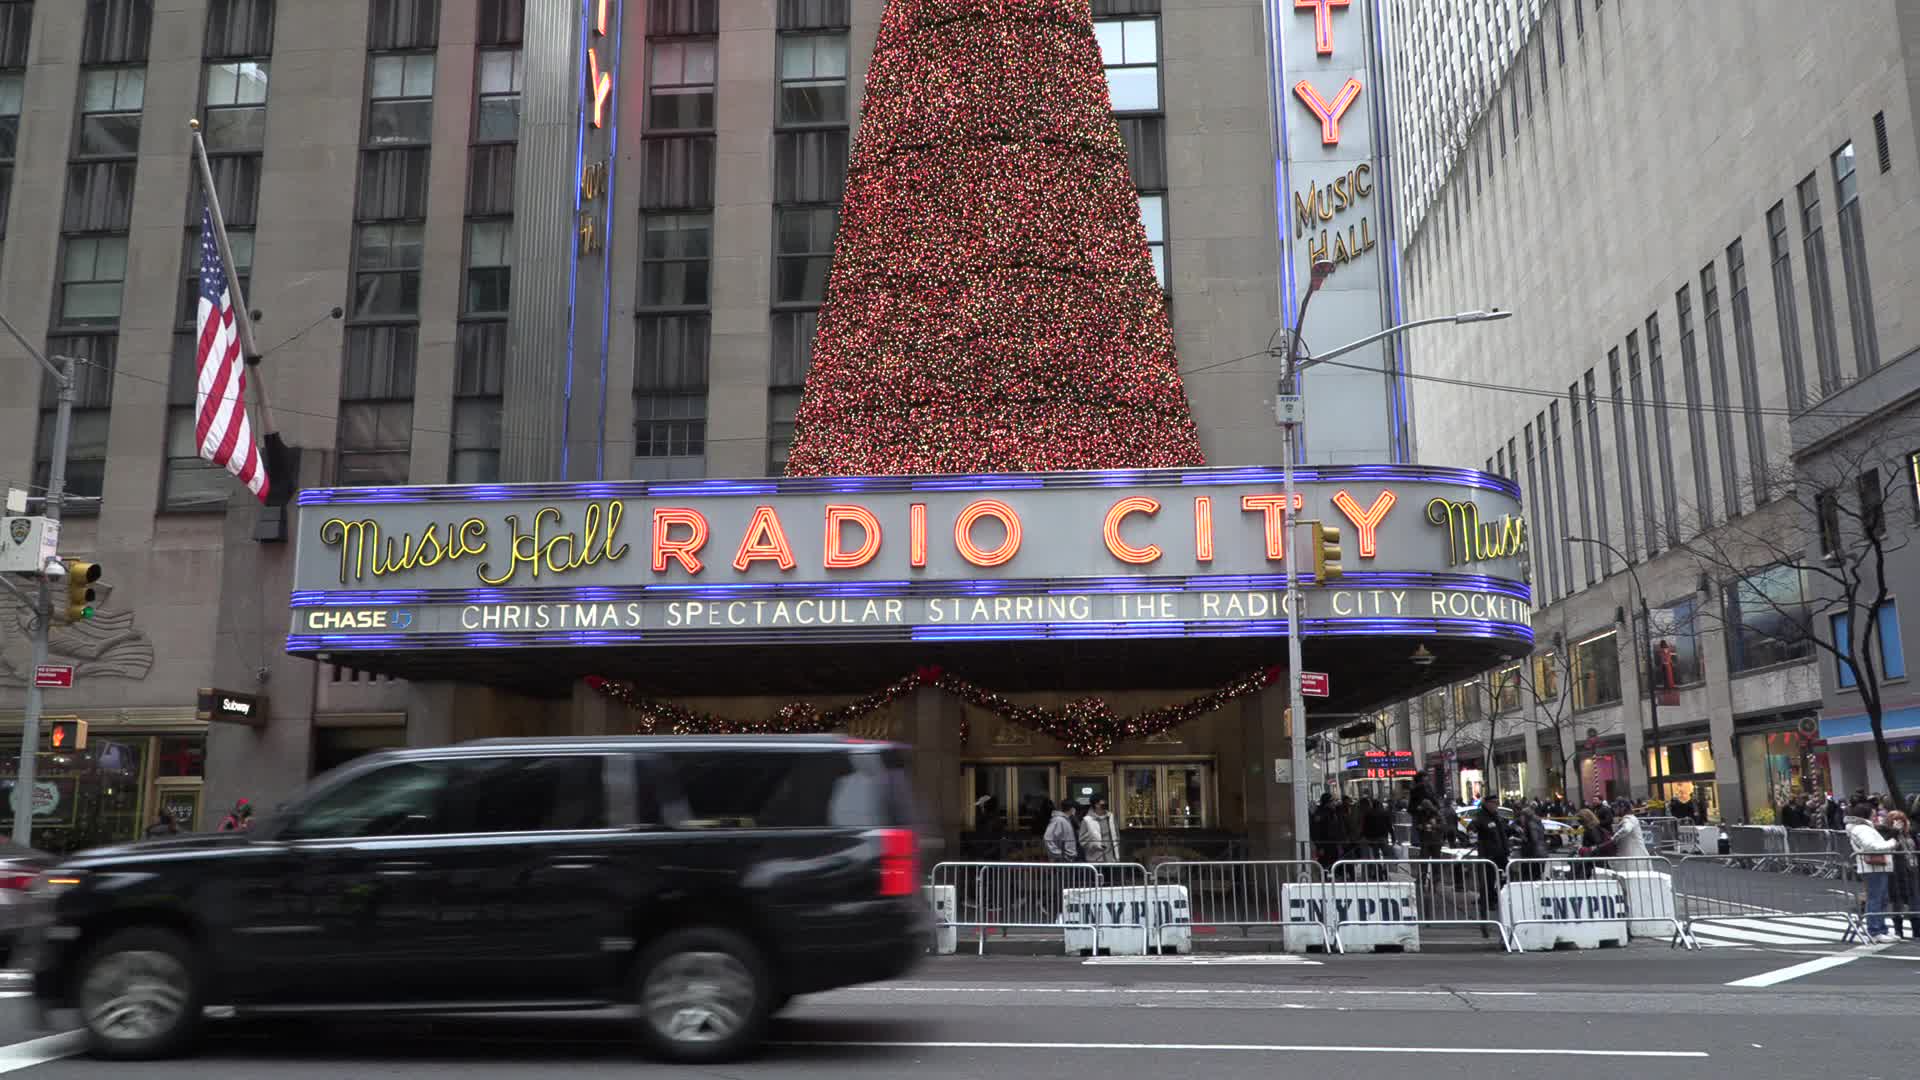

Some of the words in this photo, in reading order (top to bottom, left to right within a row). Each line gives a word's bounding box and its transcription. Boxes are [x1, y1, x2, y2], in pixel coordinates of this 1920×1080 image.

[1294, 163, 1372, 240] MUSIC
[1308, 217, 1375, 272] HALL
[320, 518, 488, 584] Music
[477, 500, 629, 585] Hall
[652, 500, 1023, 575] RADIO
[1102, 489, 1397, 564] CITY
[308, 611, 387, 629] CHASE
[462, 603, 641, 629] CHRISTMAS
[667, 599, 903, 625] SPECTACULAR
[928, 595, 1090, 624] STARRING
[1118, 593, 1177, 619] THE
[1203, 591, 1306, 618] RADIO
[1332, 590, 1407, 615] CITY
[223, 698, 250, 715] Subway
[1367, 768, 1395, 778] NBC
[1082, 901, 1173, 925] NYPD
[1307, 898, 1400, 922] NYPD
[1553, 896, 1615, 919] NYPD
